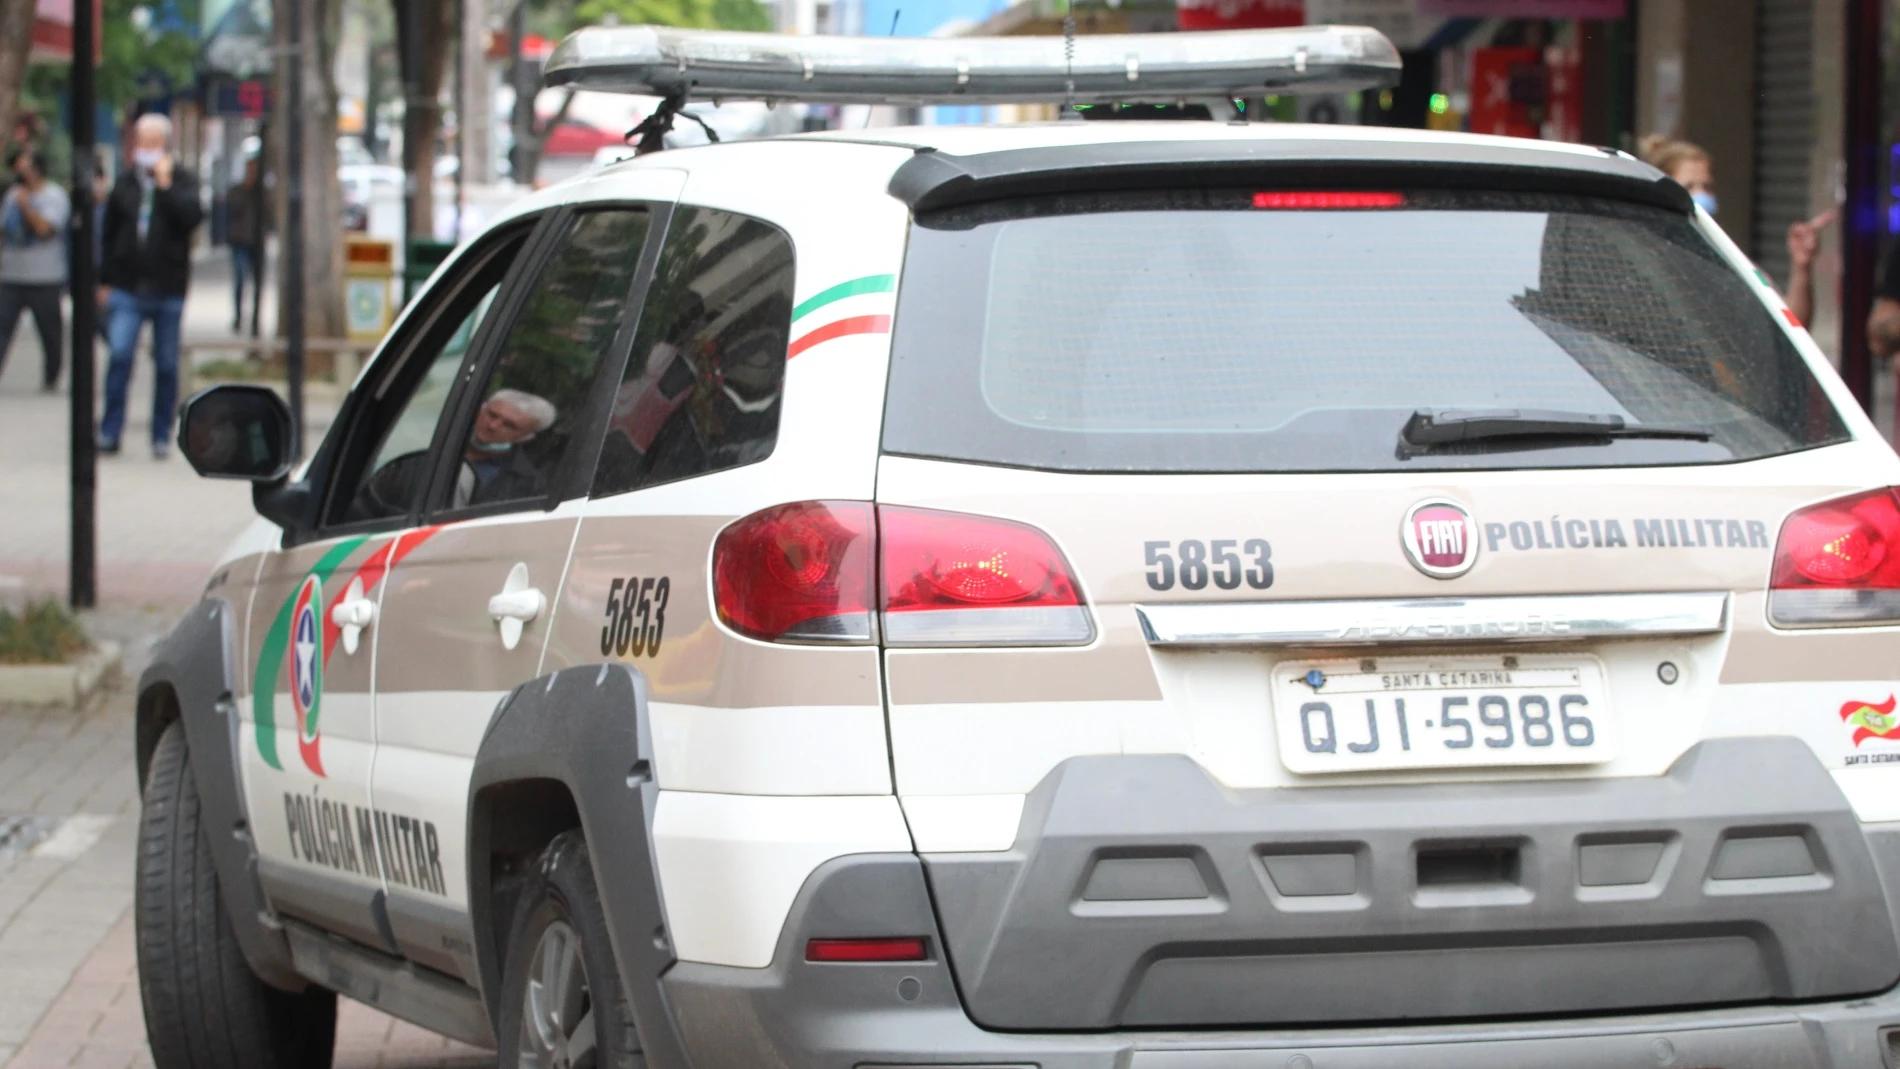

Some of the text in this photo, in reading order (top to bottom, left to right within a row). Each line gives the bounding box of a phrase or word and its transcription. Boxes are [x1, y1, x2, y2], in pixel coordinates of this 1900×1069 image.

[1420, 519, 1465, 555] FIAT
[1486, 515, 1769, 551] POLÍCIA MILITAR
[1144, 538, 1275, 591] 5853
[601, 576, 670, 658] 5853
[1382, 671, 1513, 689] SANTA CATARINA
[284, 784, 447, 896] POLÍCIA MILITAR
